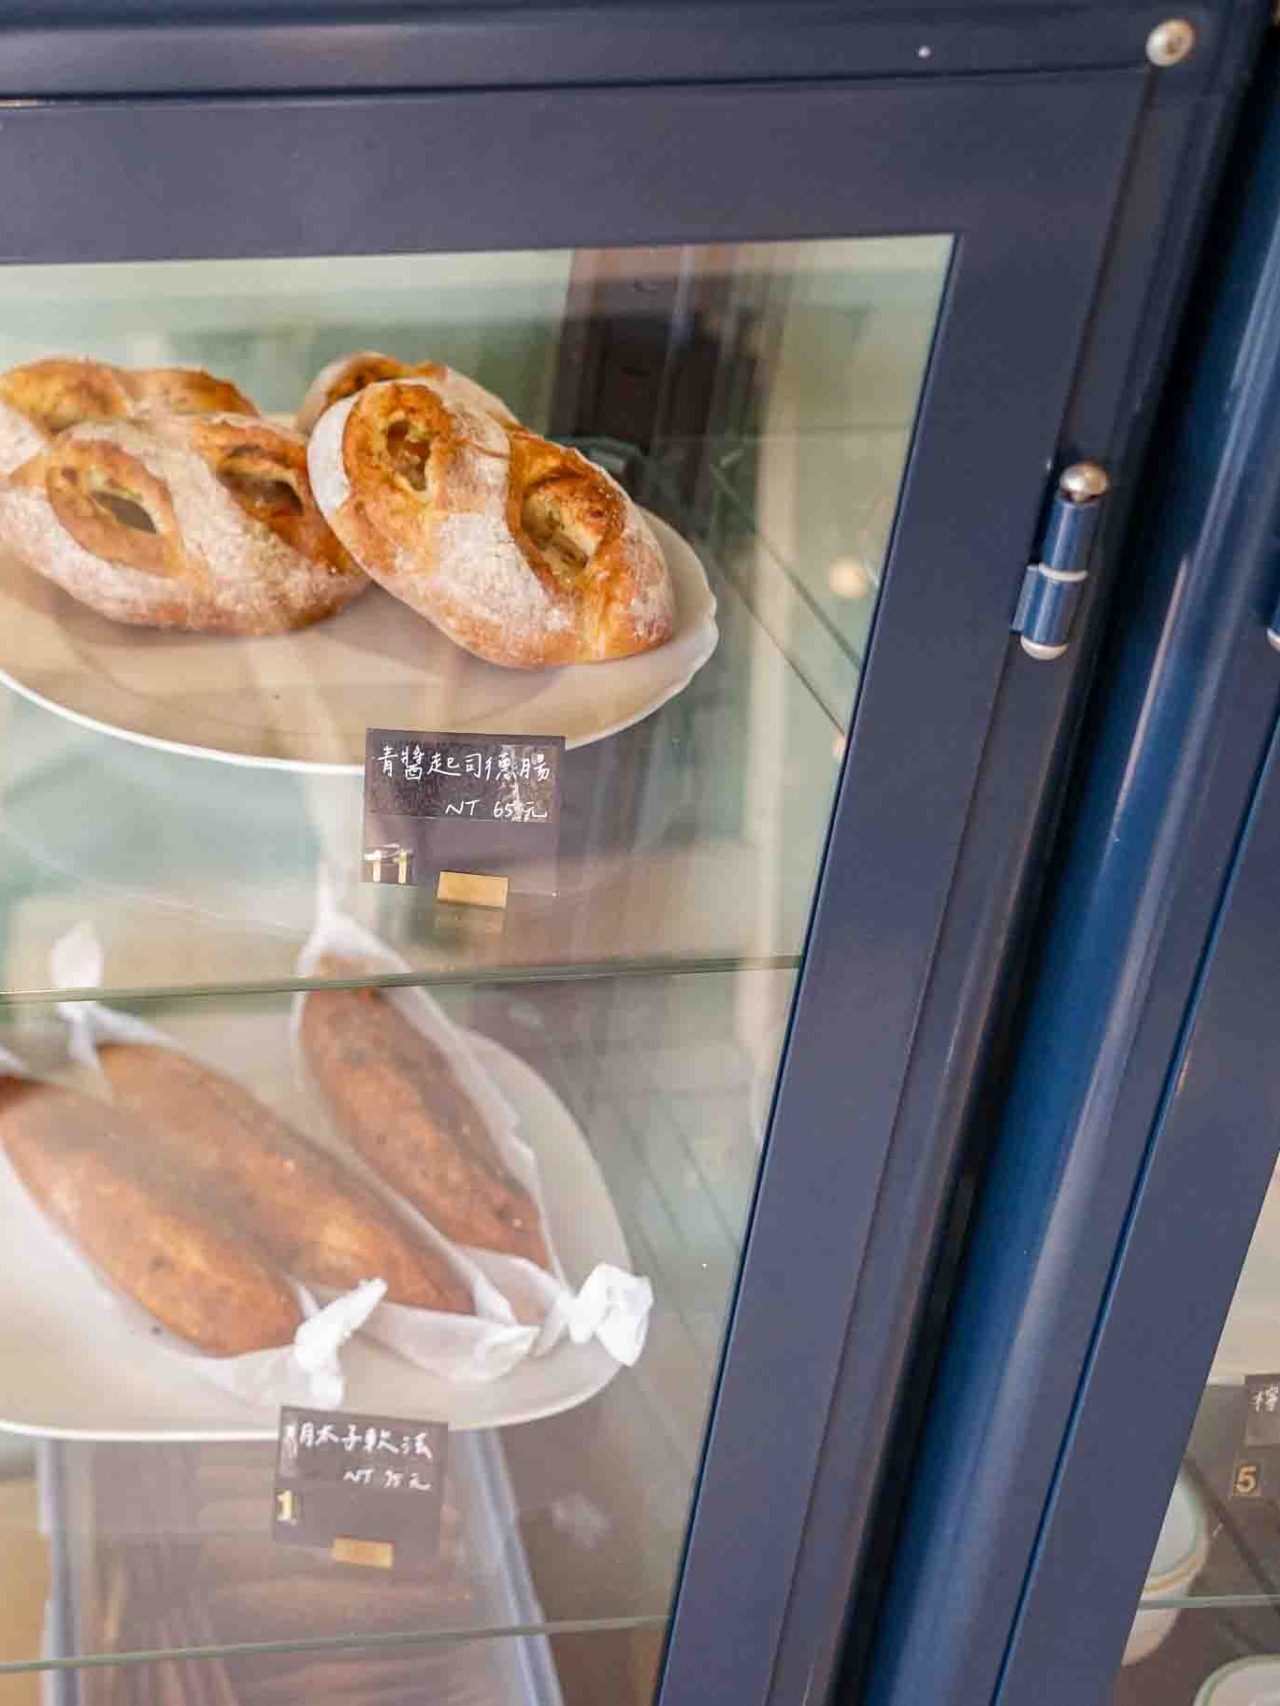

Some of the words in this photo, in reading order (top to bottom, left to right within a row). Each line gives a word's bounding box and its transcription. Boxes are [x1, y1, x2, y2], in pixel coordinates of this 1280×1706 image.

[377, 745, 550, 781] 青醬起司德腸
[445, 800, 480, 816] NT
[1236, 1465, 1257, 1493] 5
[277, 1490, 296, 1525] 1
